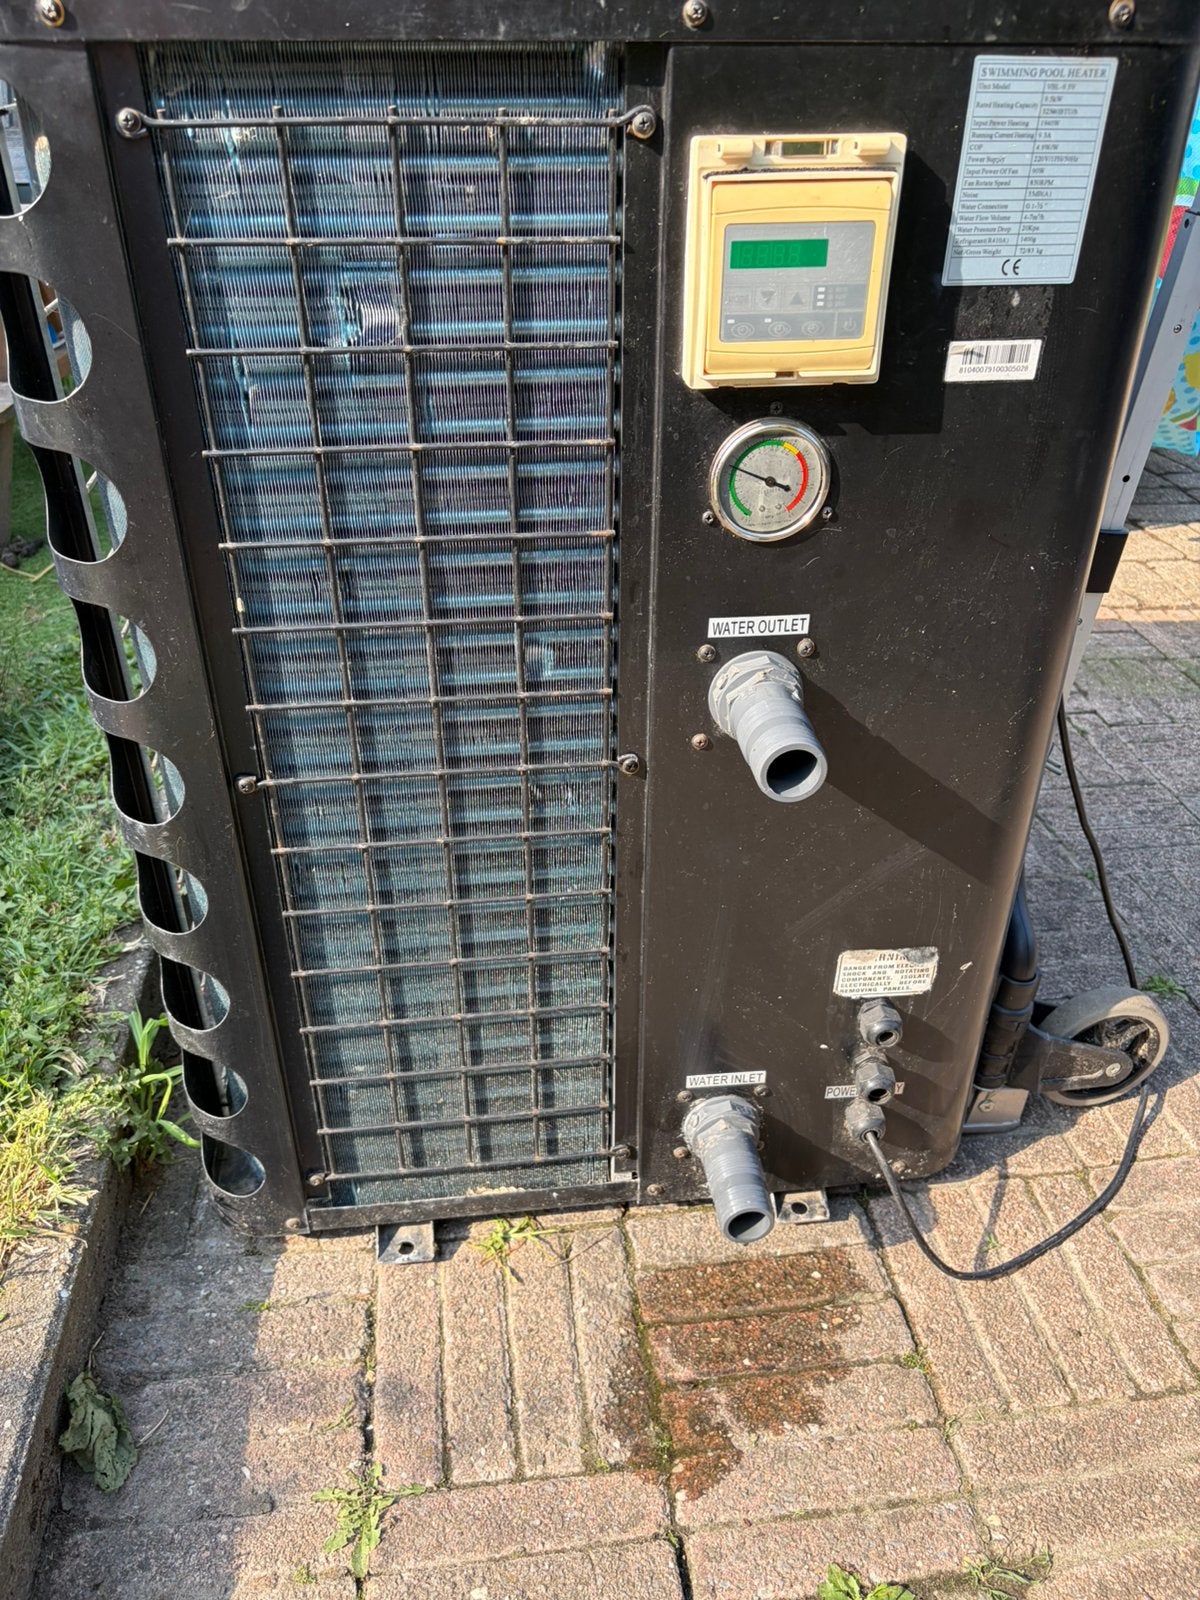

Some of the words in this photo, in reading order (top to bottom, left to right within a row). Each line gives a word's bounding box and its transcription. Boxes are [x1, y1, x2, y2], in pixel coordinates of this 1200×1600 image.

[981, 67, 1037, 78] SWIMMING
[1039, 68, 1065, 78] POOL
[1067, 68, 1107, 78] HEATER
[992, 82, 1011, 90] Model
[992, 102, 1014, 110] Heating
[1015, 102, 1038, 110] Capacity
[973, 120, 988, 128] Input
[1007, 120, 1030, 128] Heating
[971, 132, 992, 140] Running
[1012, 132, 1035, 140] Heating
[997, 226, 1012, 234] Drop
[982, 249, 1002, 257] Weight
[1001, 258, 1022, 276] CE
[712, 620, 755, 636] WATER
[757, 617, 808, 634] OUTLET
[689, 1075, 728, 1086] WATER
[731, 1073, 763, 1084] INLET
